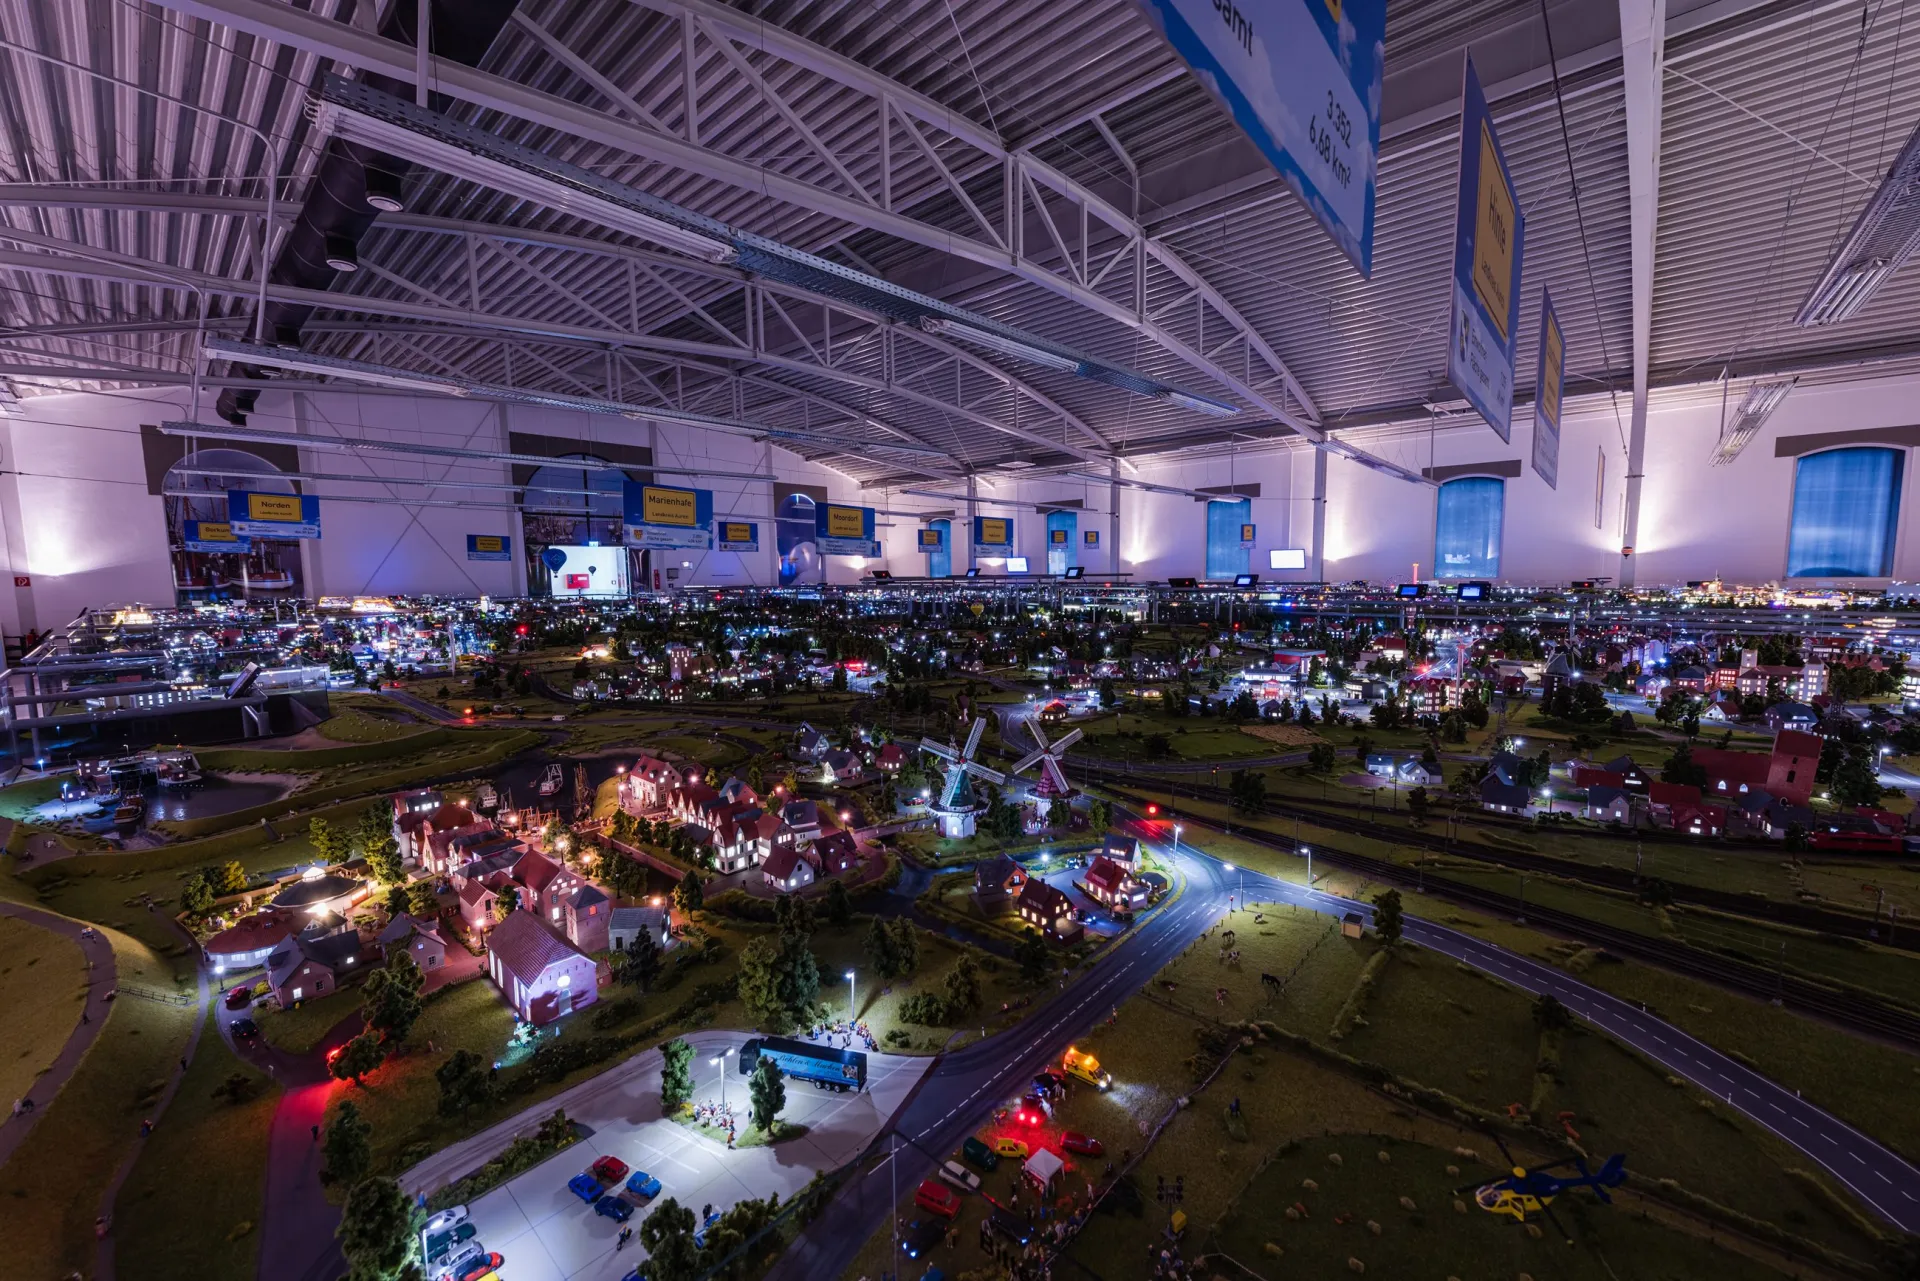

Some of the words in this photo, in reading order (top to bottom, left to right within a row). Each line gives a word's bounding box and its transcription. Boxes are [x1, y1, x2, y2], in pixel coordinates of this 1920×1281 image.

[1327, 90, 1351, 149] 3.352
[1332, 145, 1351, 189] km²
[261, 501, 291, 509] Norden
[648, 495, 692, 507] Marienhafe
[833, 513, 858, 522] Moordorf
